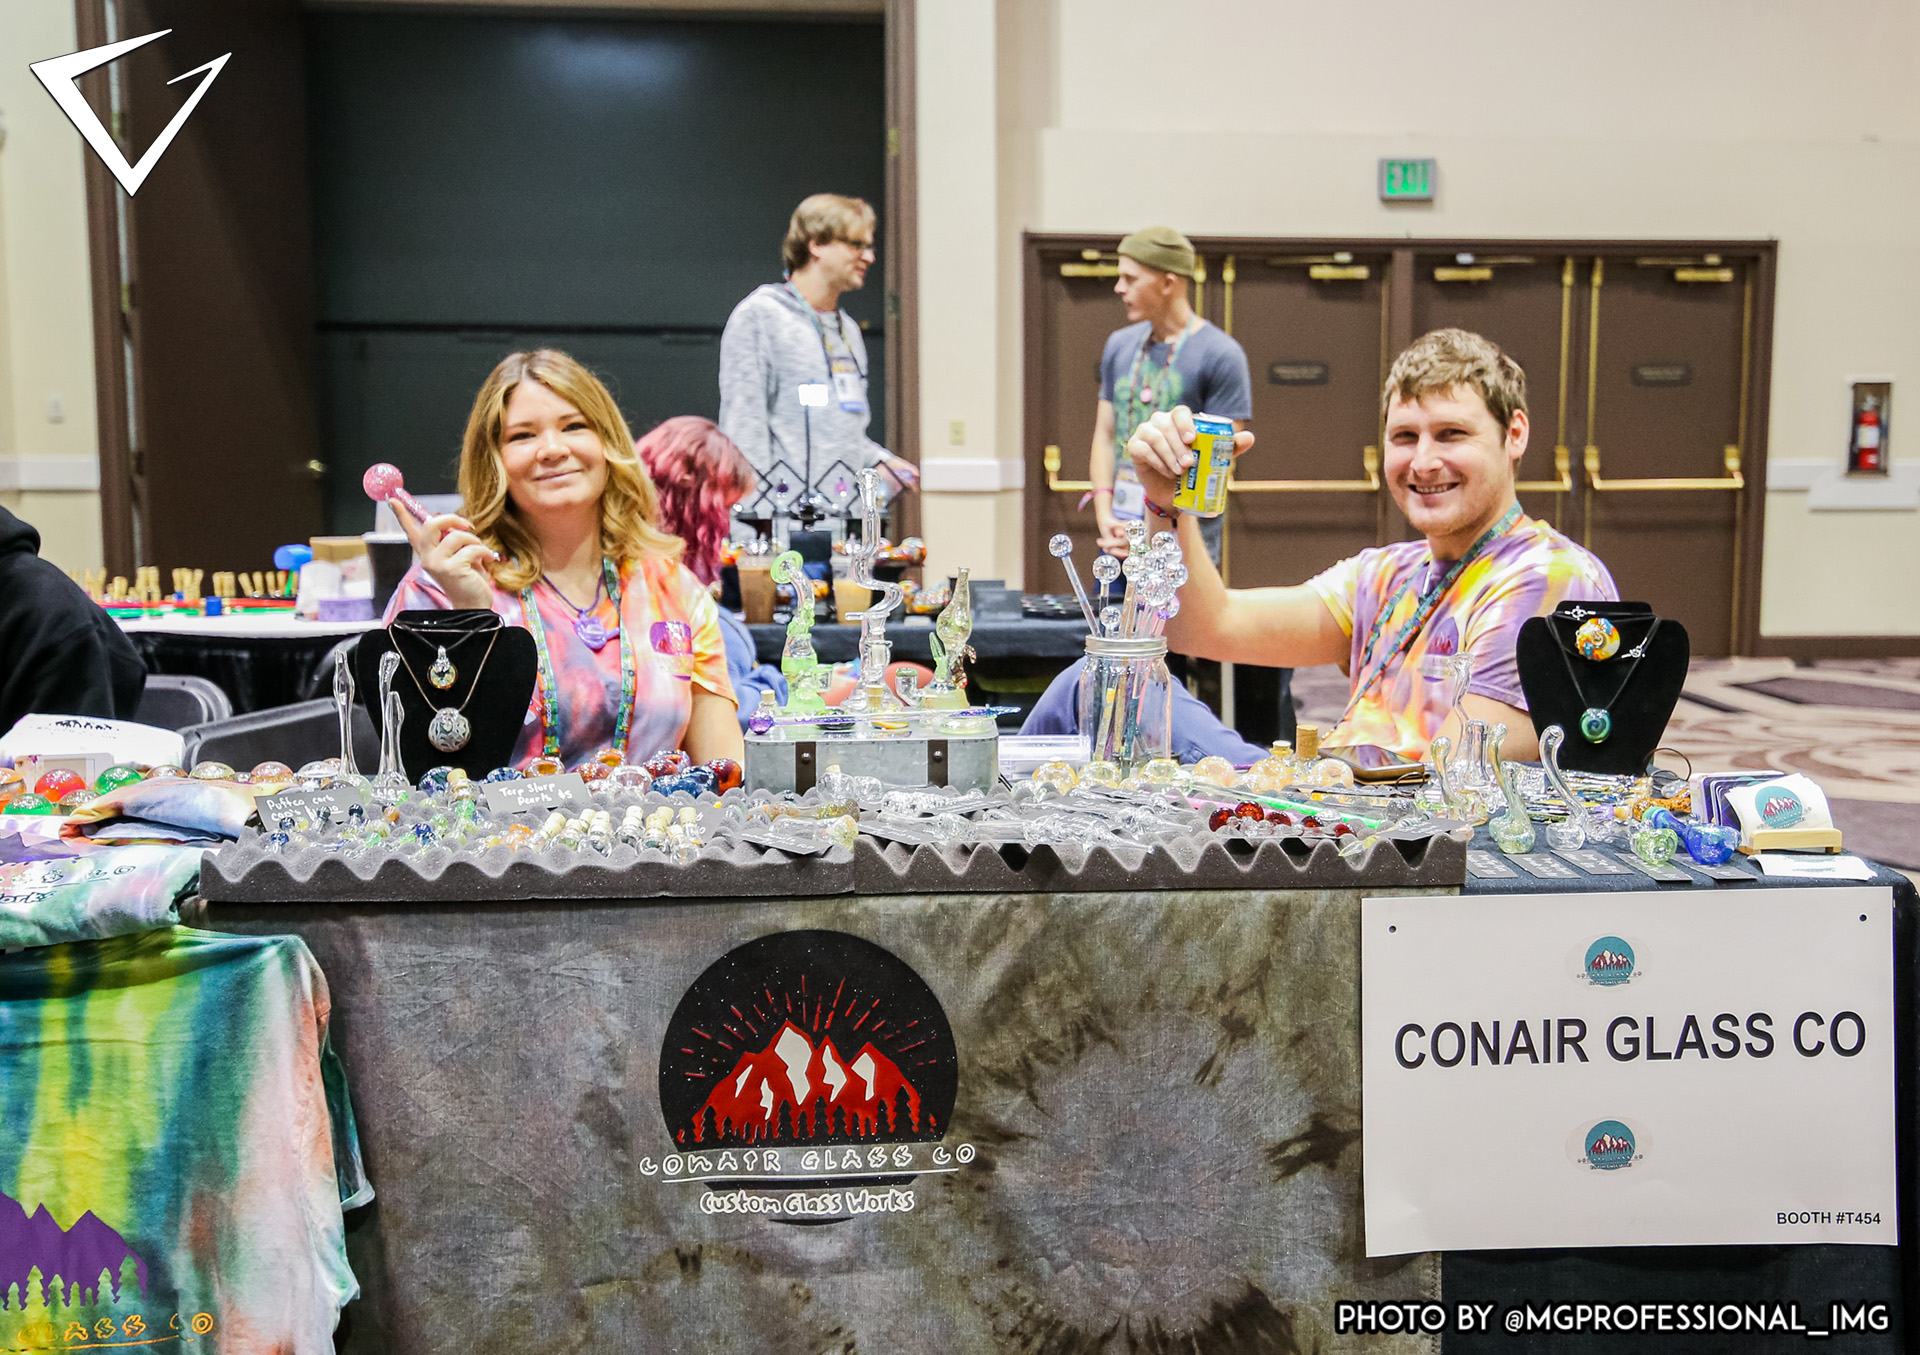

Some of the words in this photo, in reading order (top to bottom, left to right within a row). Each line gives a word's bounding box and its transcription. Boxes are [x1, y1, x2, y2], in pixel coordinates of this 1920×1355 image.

[1386, 161, 1429, 195] EXIT
[498, 786, 525, 797] Terp
[526, 782, 556, 793] Slurp
[557, 788, 573, 800] $5
[266, 797, 305, 810] Puffco
[1395, 1018, 1590, 1070] CONAIR
[1606, 1012, 1775, 1063] GLASS
[1792, 1010, 1867, 1059] CO
[639, 1150, 782, 1176] CONAIR
[799, 1146, 913, 1170] GLASS
[932, 1143, 976, 1164] CO
[699, 1190, 781, 1215] Custom
[783, 1193, 843, 1216] Glass
[845, 1189, 915, 1214] Works
[1776, 1211, 1832, 1225] BOOTH
[1835, 1211, 1882, 1225] #T454
